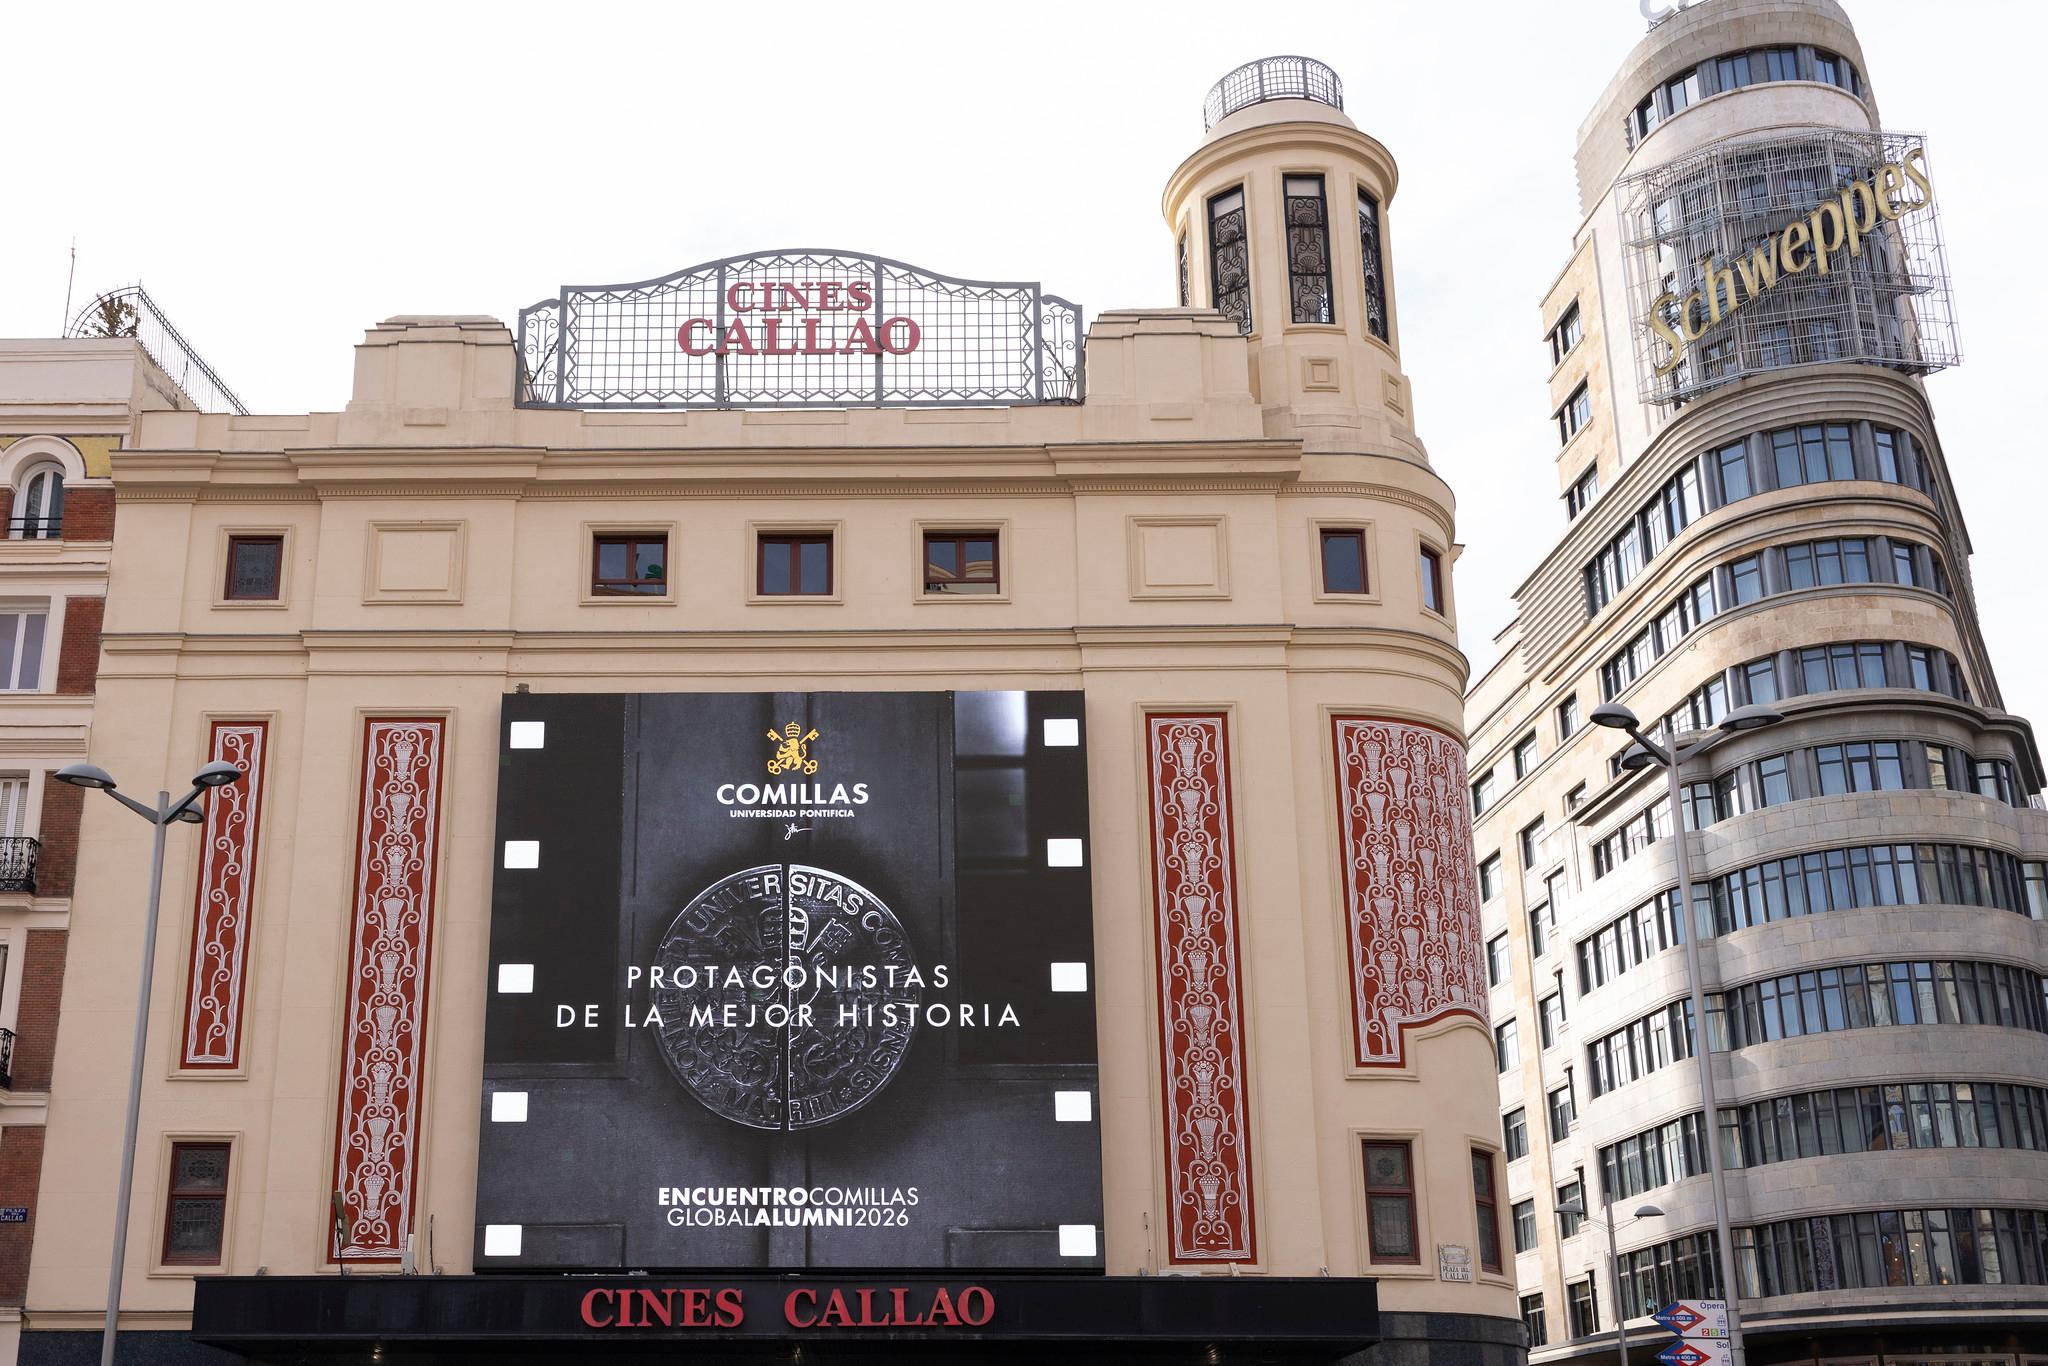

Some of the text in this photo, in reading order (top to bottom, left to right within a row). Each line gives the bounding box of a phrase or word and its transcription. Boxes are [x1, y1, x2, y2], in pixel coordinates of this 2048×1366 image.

[1647, 147, 1933, 377] Schweppes
[727, 281, 873, 312] CINES
[677, 316, 921, 356] CALLAO
[716, 782, 869, 805] COMILLAS
[729, 809, 855, 818] UNIVERSIDAD PONTIFICIA
[689, 873, 864, 932] UNIVERSITAS
[627, 964, 949, 989] PROTAGONISTAS
[556, 1003, 1021, 1028] DE LA MEJOR HISTORIA
[658, 1187, 919, 1206] ENCUENTROCOMILLAS
[667, 1208, 909, 1227] GLOBALALUMNI2026
[1445, 1272, 1469, 1280] CALLAO
[581, 1286, 996, 1328] CINES CALLAO
[1700, 1300, 1725, 1310] Ópera
[1716, 1341, 1730, 1349] Sol
